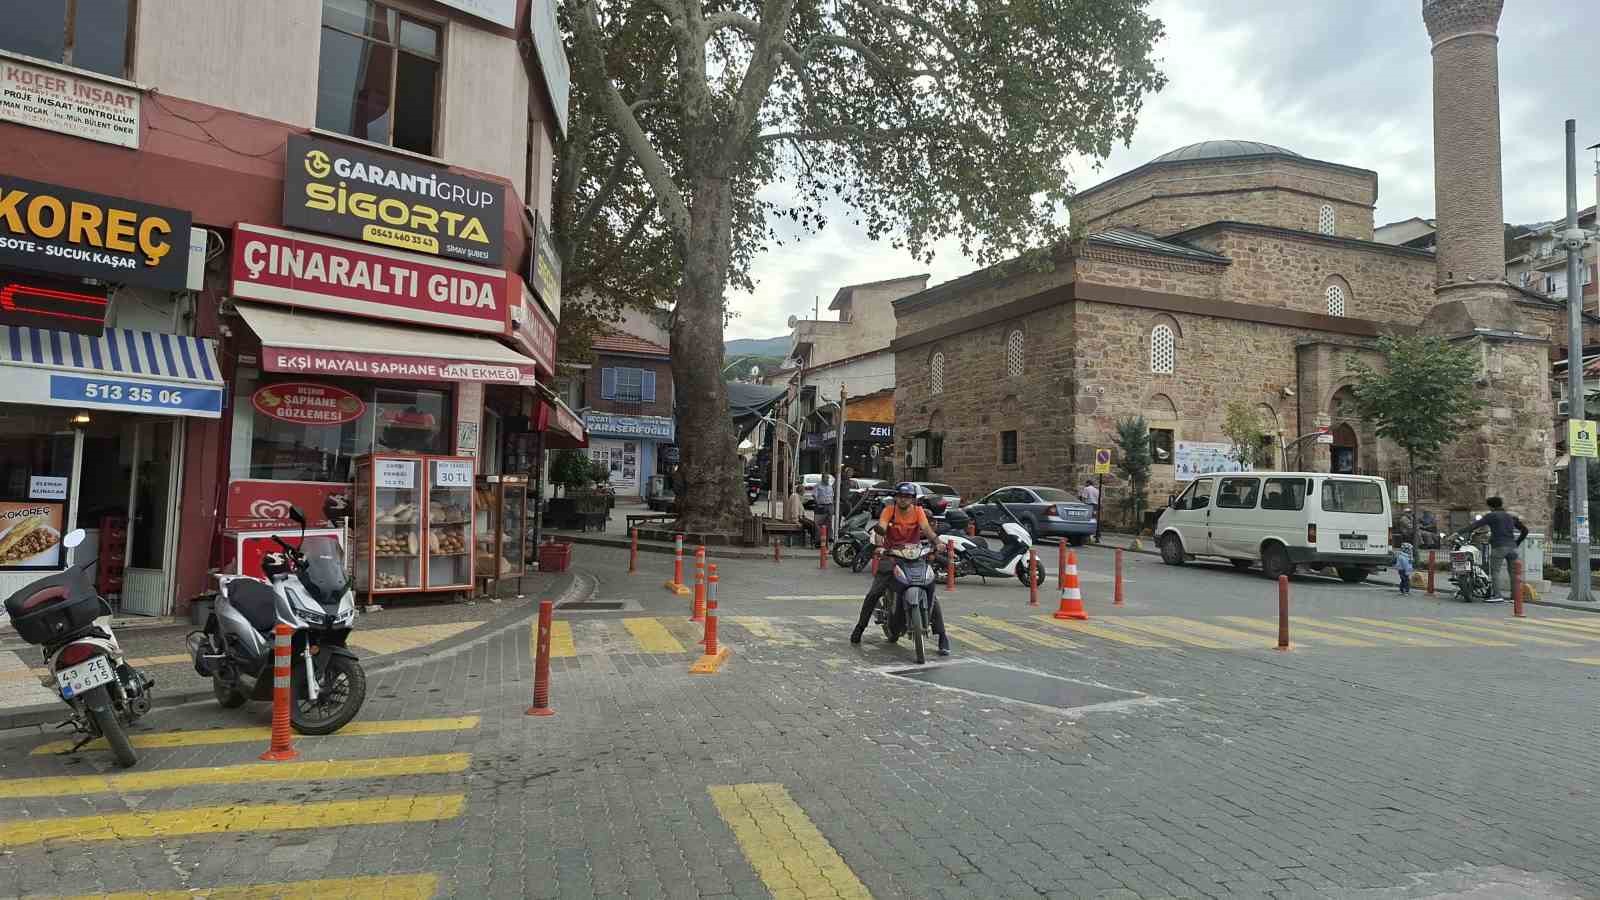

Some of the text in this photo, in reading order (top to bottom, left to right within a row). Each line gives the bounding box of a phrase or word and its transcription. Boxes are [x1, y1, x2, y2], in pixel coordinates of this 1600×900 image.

[4, 89, 32, 102] PROJE
[305, 181, 491, 244] SİGORTA
[371, 228, 393, 239] 0543
[46, 245, 91, 262] SUCUK
[92, 253, 136, 269] KAŞAR
[243, 240, 419, 298] ÇINARALTI
[427, 273, 497, 310] GIDA
[277, 355, 311, 370] EKŞİ
[315, 358, 367, 372] MAYALI
[371, 362, 436, 376] ŞAPHANE
[442, 366, 468, 377] HAN
[471, 367, 518, 380] EKMEĞİ
[85, 383, 183, 404] 513 35 06
[284, 395, 337, 408] ŞAPHANE
[441, 473, 468, 482] 30 TL
[63, 670, 78, 681] 43
[85, 671, 109, 686] 615
